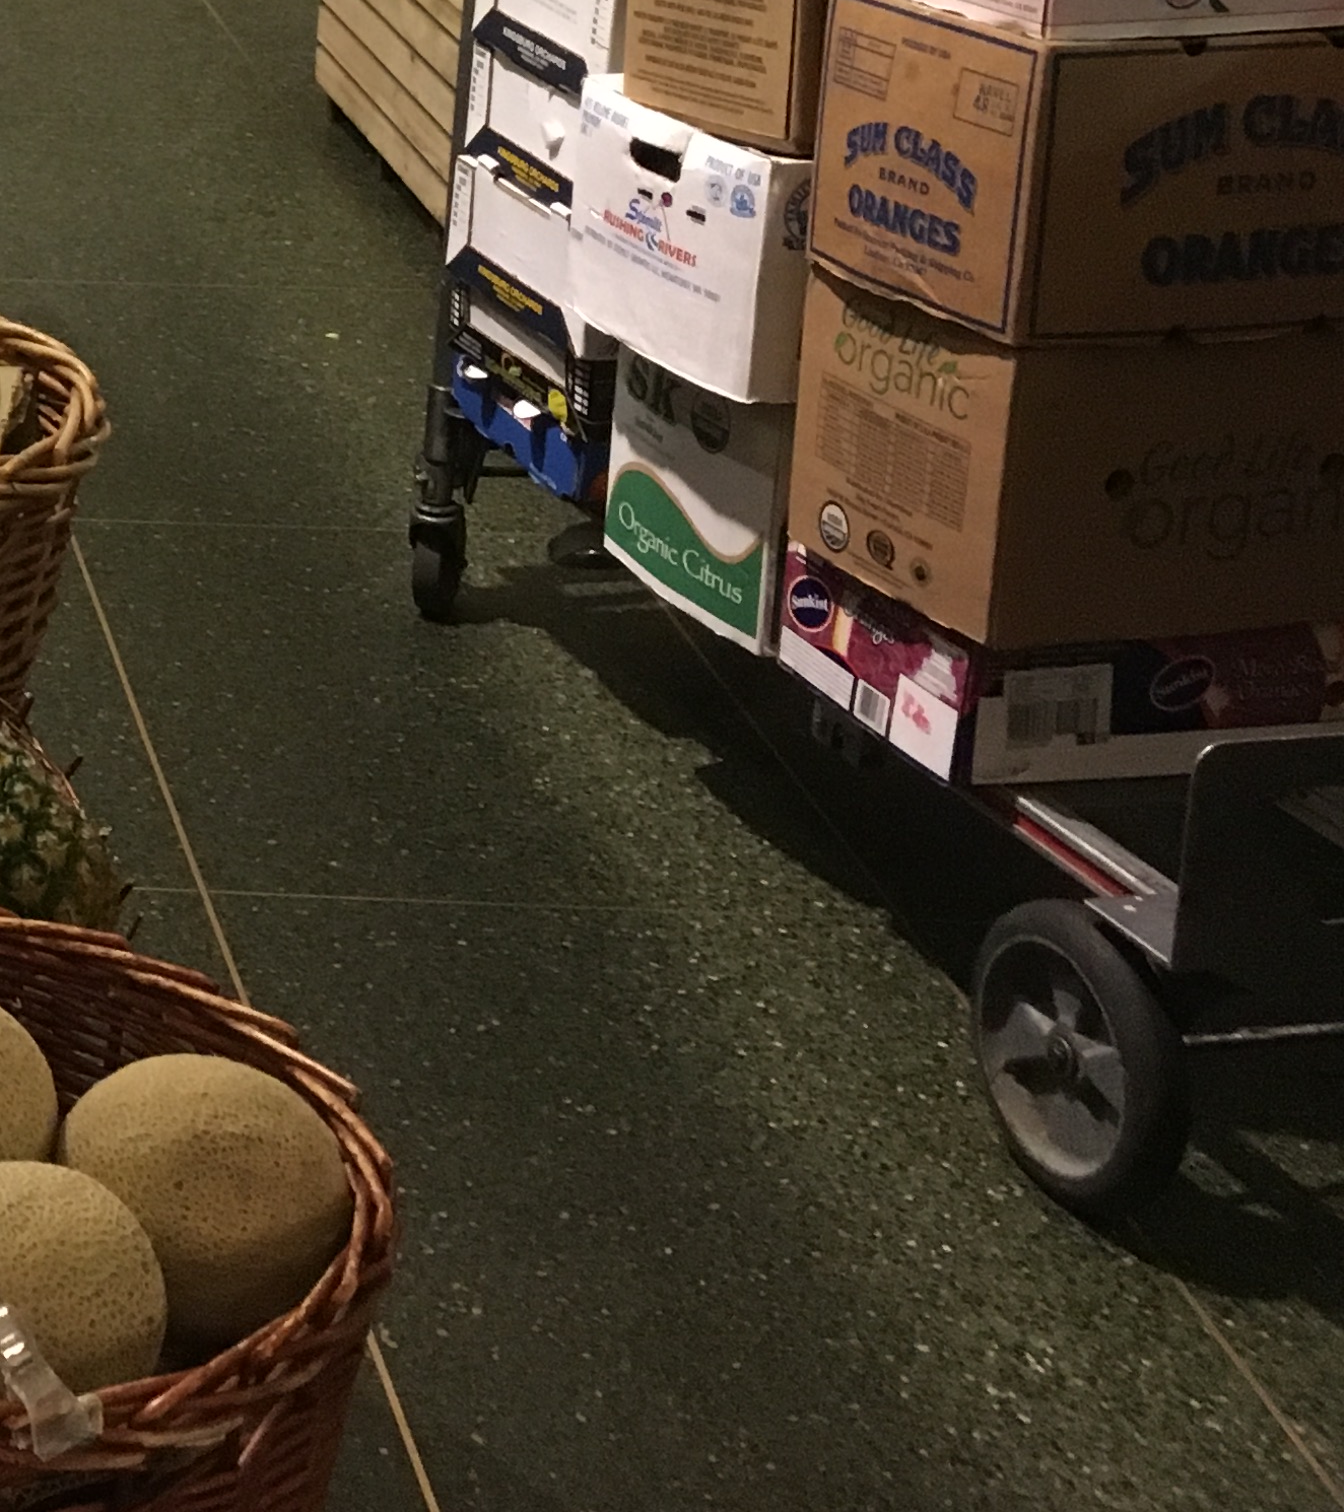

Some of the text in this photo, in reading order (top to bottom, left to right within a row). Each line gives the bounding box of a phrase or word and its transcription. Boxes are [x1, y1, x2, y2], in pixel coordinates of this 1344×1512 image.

[1243, 94, 1344, 156] CLA
[843, 121, 889, 170] SUN
[893, 125, 979, 217] CLASS
[878, 166, 931, 196] BRAND
[602, 208, 644, 243] RUSHING
[657, 238, 698, 269] RIVERS
[847, 183, 961, 257] ORANGES
[1140, 224, 1344, 288] ORANGE
[836, 331, 971, 421] organic
[618, 500, 743, 605] Organic Citrus
[791, 593, 829, 613] Sunkist
